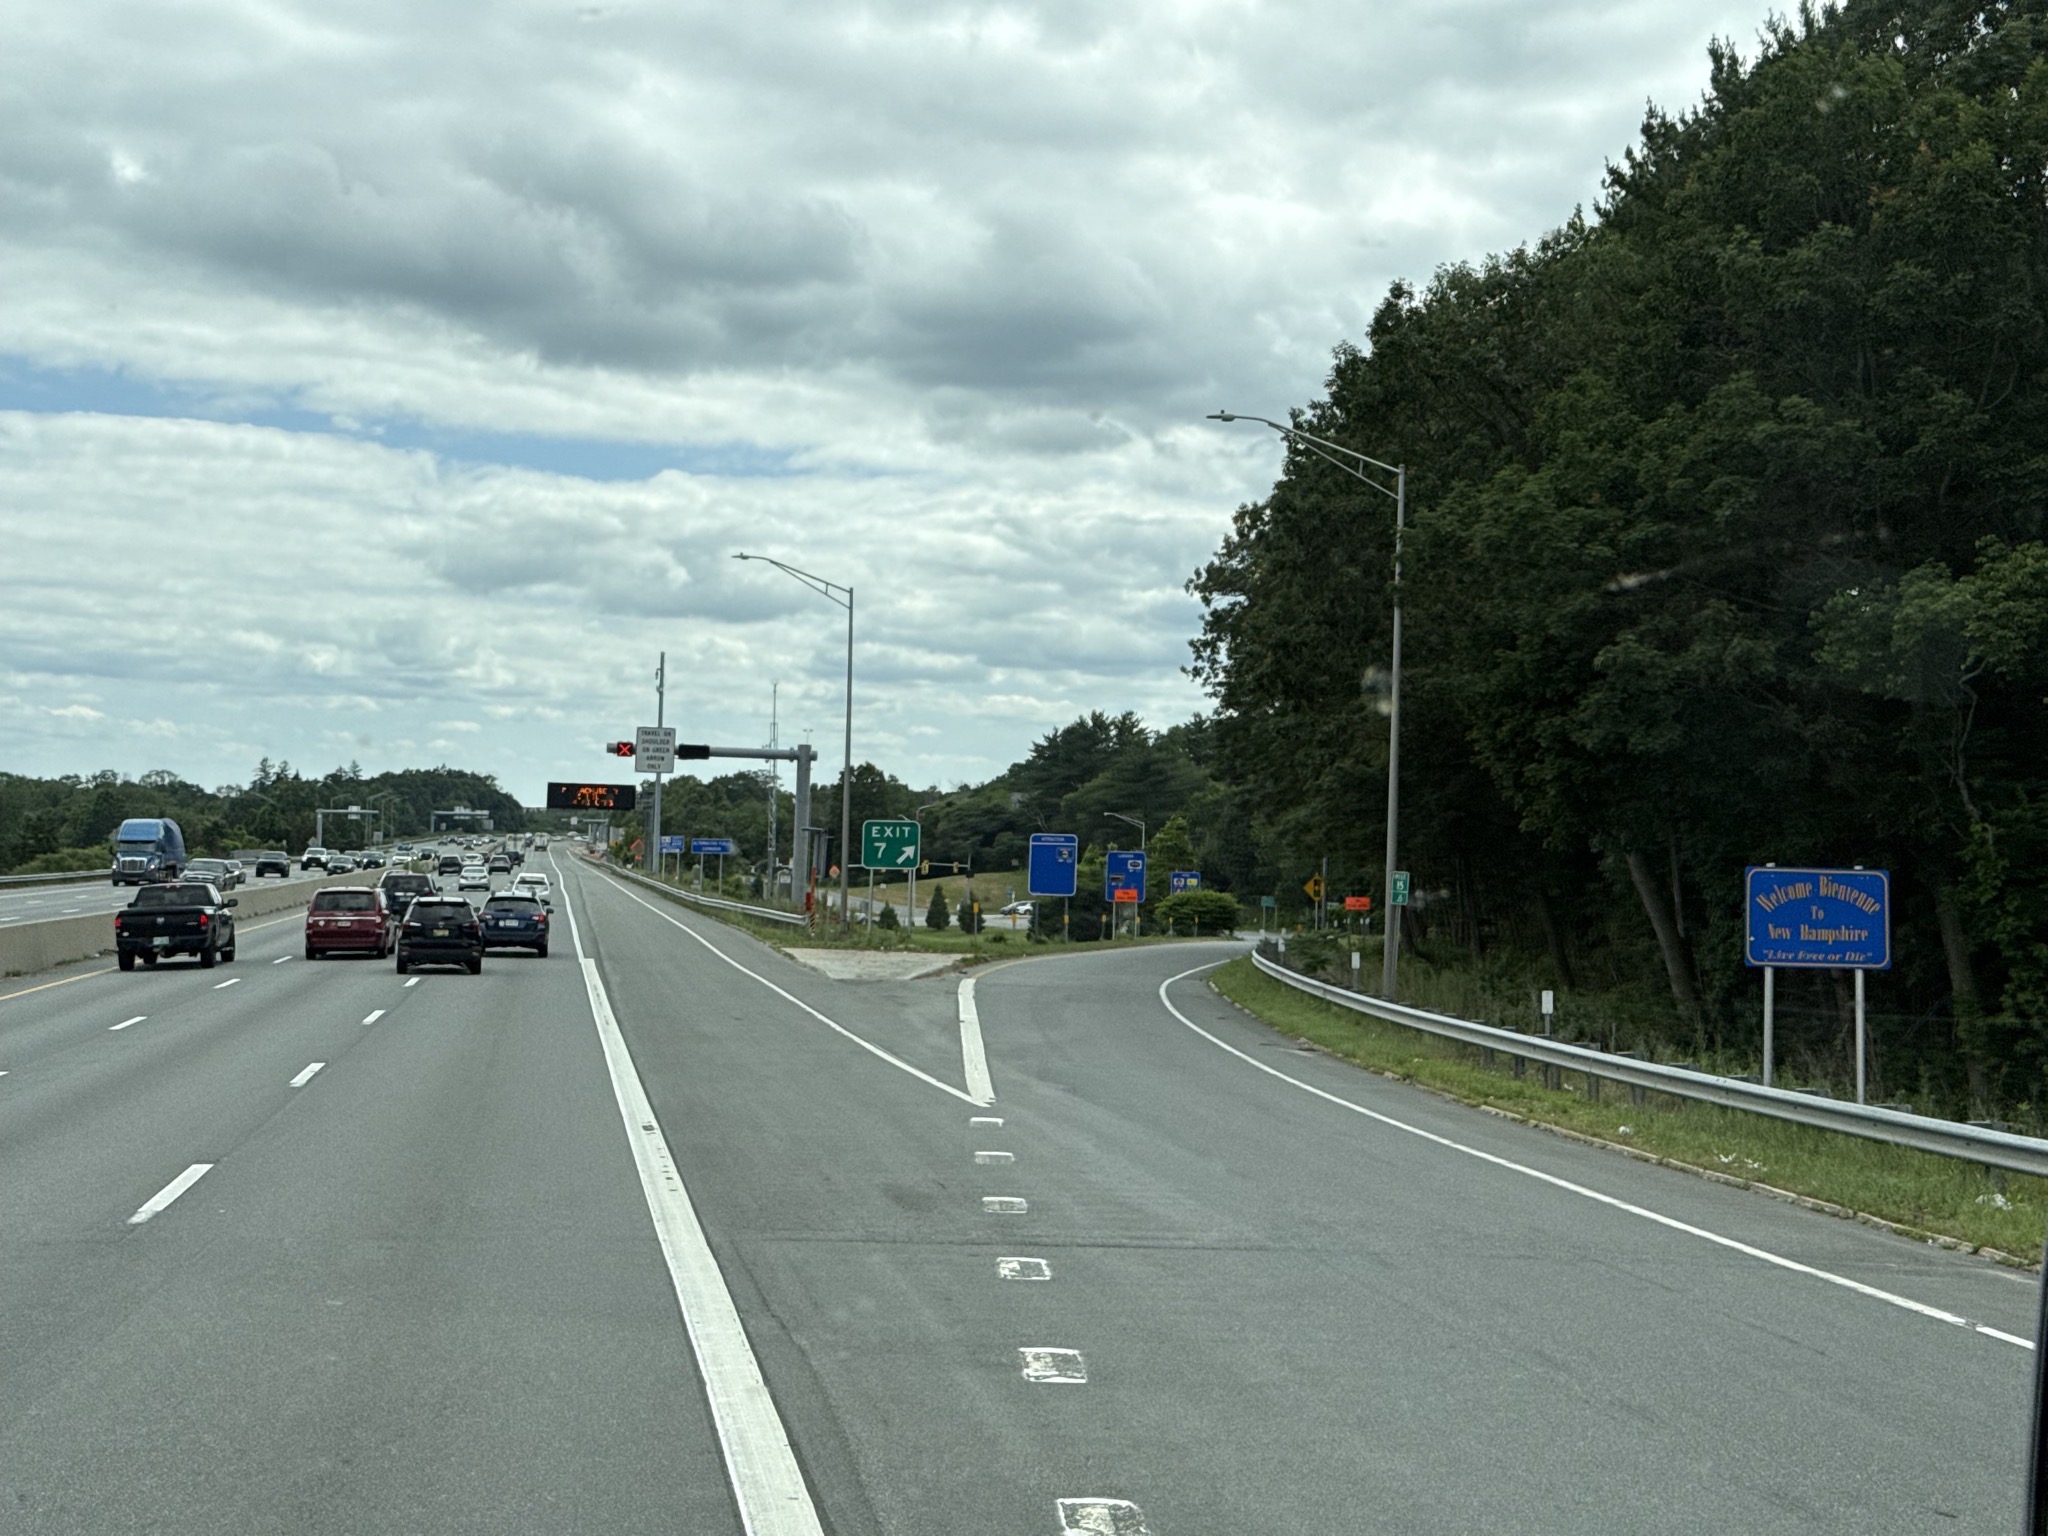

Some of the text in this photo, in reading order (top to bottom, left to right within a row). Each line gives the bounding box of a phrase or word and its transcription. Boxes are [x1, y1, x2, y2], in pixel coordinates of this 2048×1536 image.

[871, 826, 911, 838] EXIT
[873, 842, 887, 859] 7
[1396, 880, 1404, 890] 15
[1756, 875, 1881, 915] Welcome Bienvenue
[1811, 905, 1824, 920] To
[1768, 923, 1868, 945] New Hampshire
[1827, 953, 1842, 961] or
